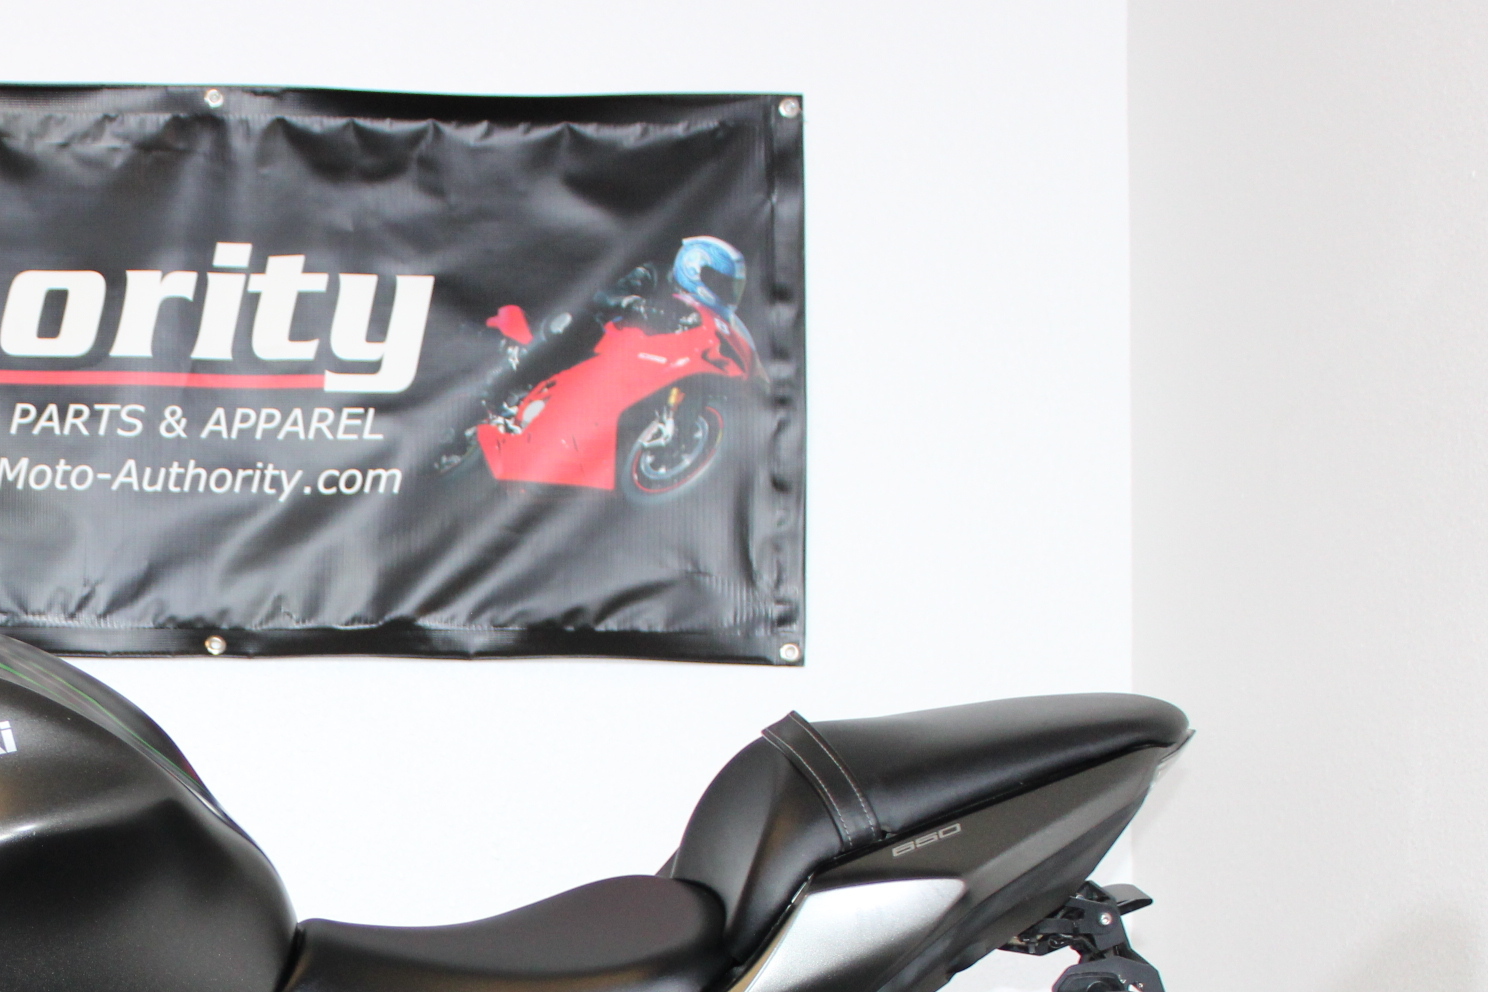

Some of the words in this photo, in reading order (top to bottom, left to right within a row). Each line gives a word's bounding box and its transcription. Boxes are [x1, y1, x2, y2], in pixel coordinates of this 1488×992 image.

[11, 403, 146, 437] PARTS
[158, 406, 188, 439] &
[200, 406, 384, 441] APPAREL
[891, 822, 962, 858] 650
